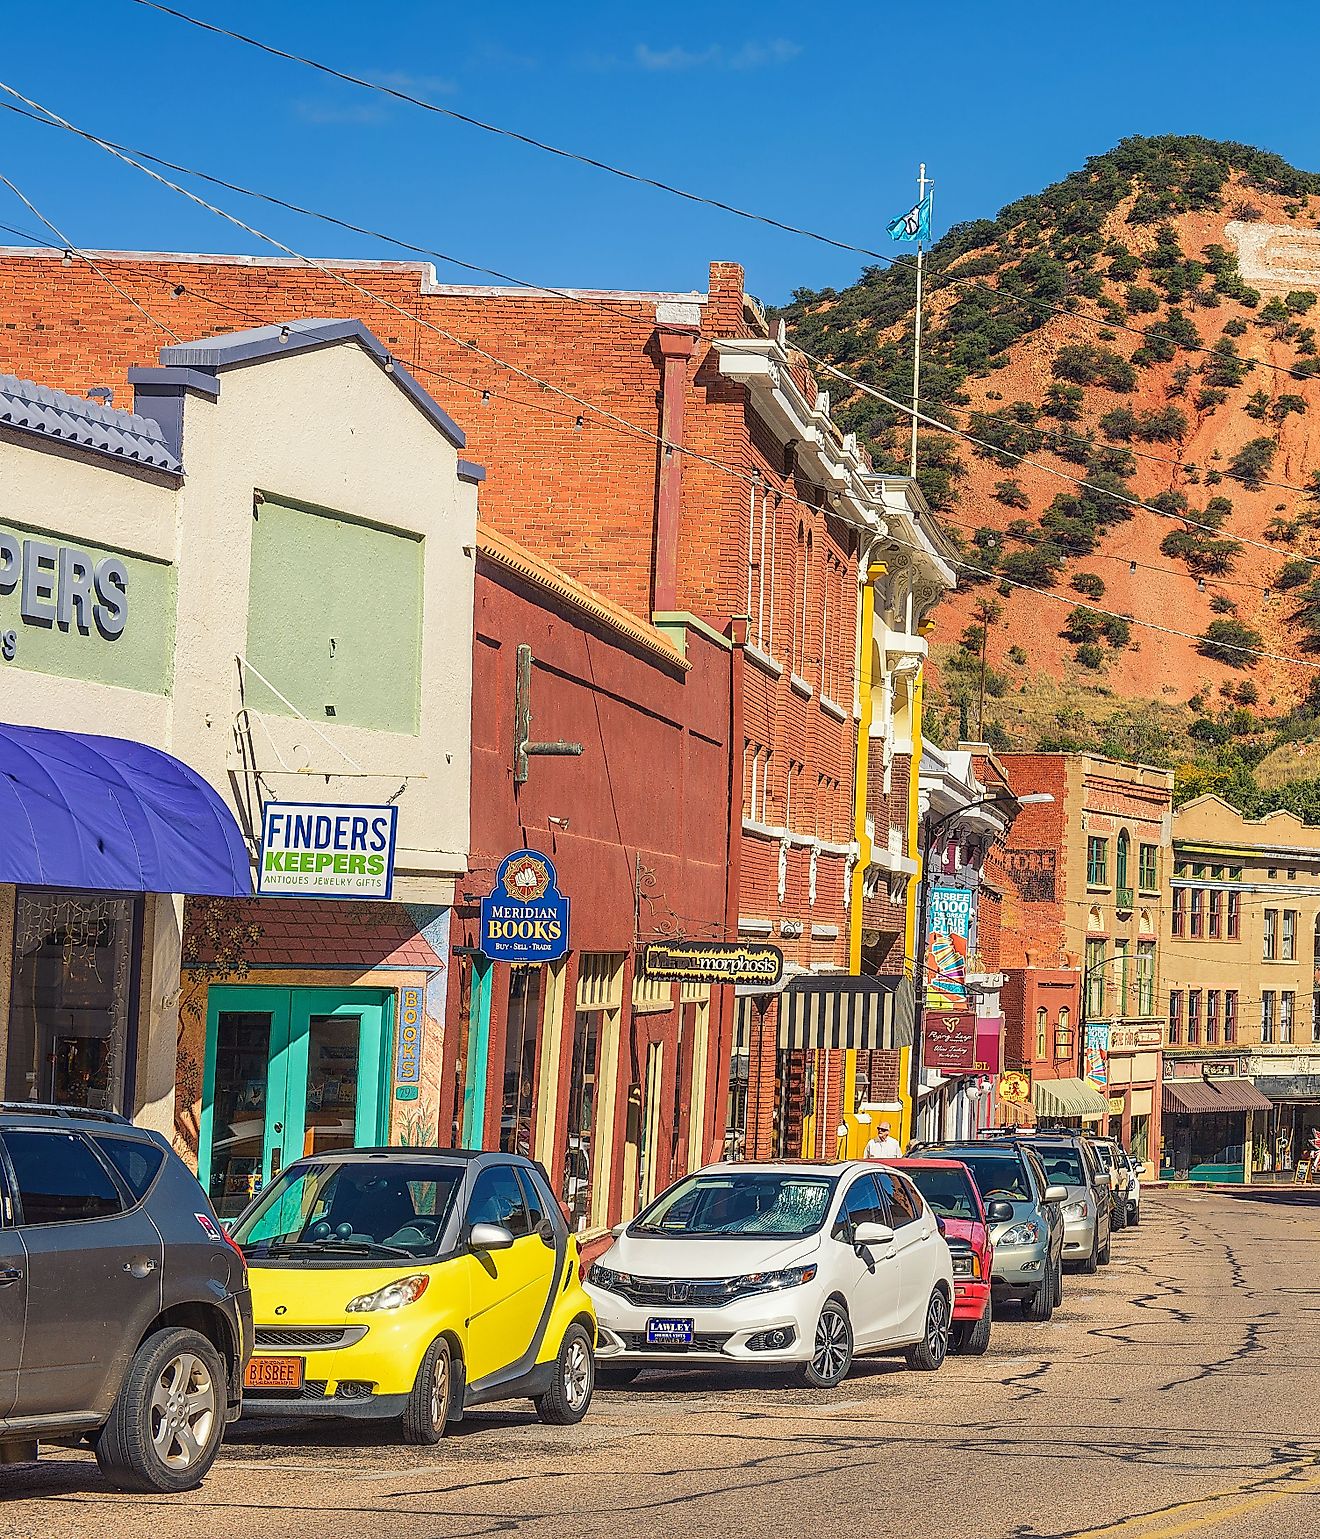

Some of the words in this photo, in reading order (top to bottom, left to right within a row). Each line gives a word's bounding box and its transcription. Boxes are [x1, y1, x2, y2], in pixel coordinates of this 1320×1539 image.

[267, 814, 388, 852] FINDERS
[264, 851, 385, 876] KEEPERS
[264, 875, 309, 885] ANTIQUES
[312, 876, 352, 887] JEWELRY
[355, 878, 382, 888] GIFTS
[933, 892, 970, 902] BISBEE
[492, 905, 557, 919] MERIDIAN
[932, 899, 969, 913] 1000
[933, 917, 965, 927] STAIR
[487, 920, 562, 942] BOOKS
[933, 925, 965, 935] CLIMB
[402, 991, 418, 1078] BOOKS
[650, 1322, 690, 1331] LAWLEY
[250, 1364, 294, 1380] BISBEE
